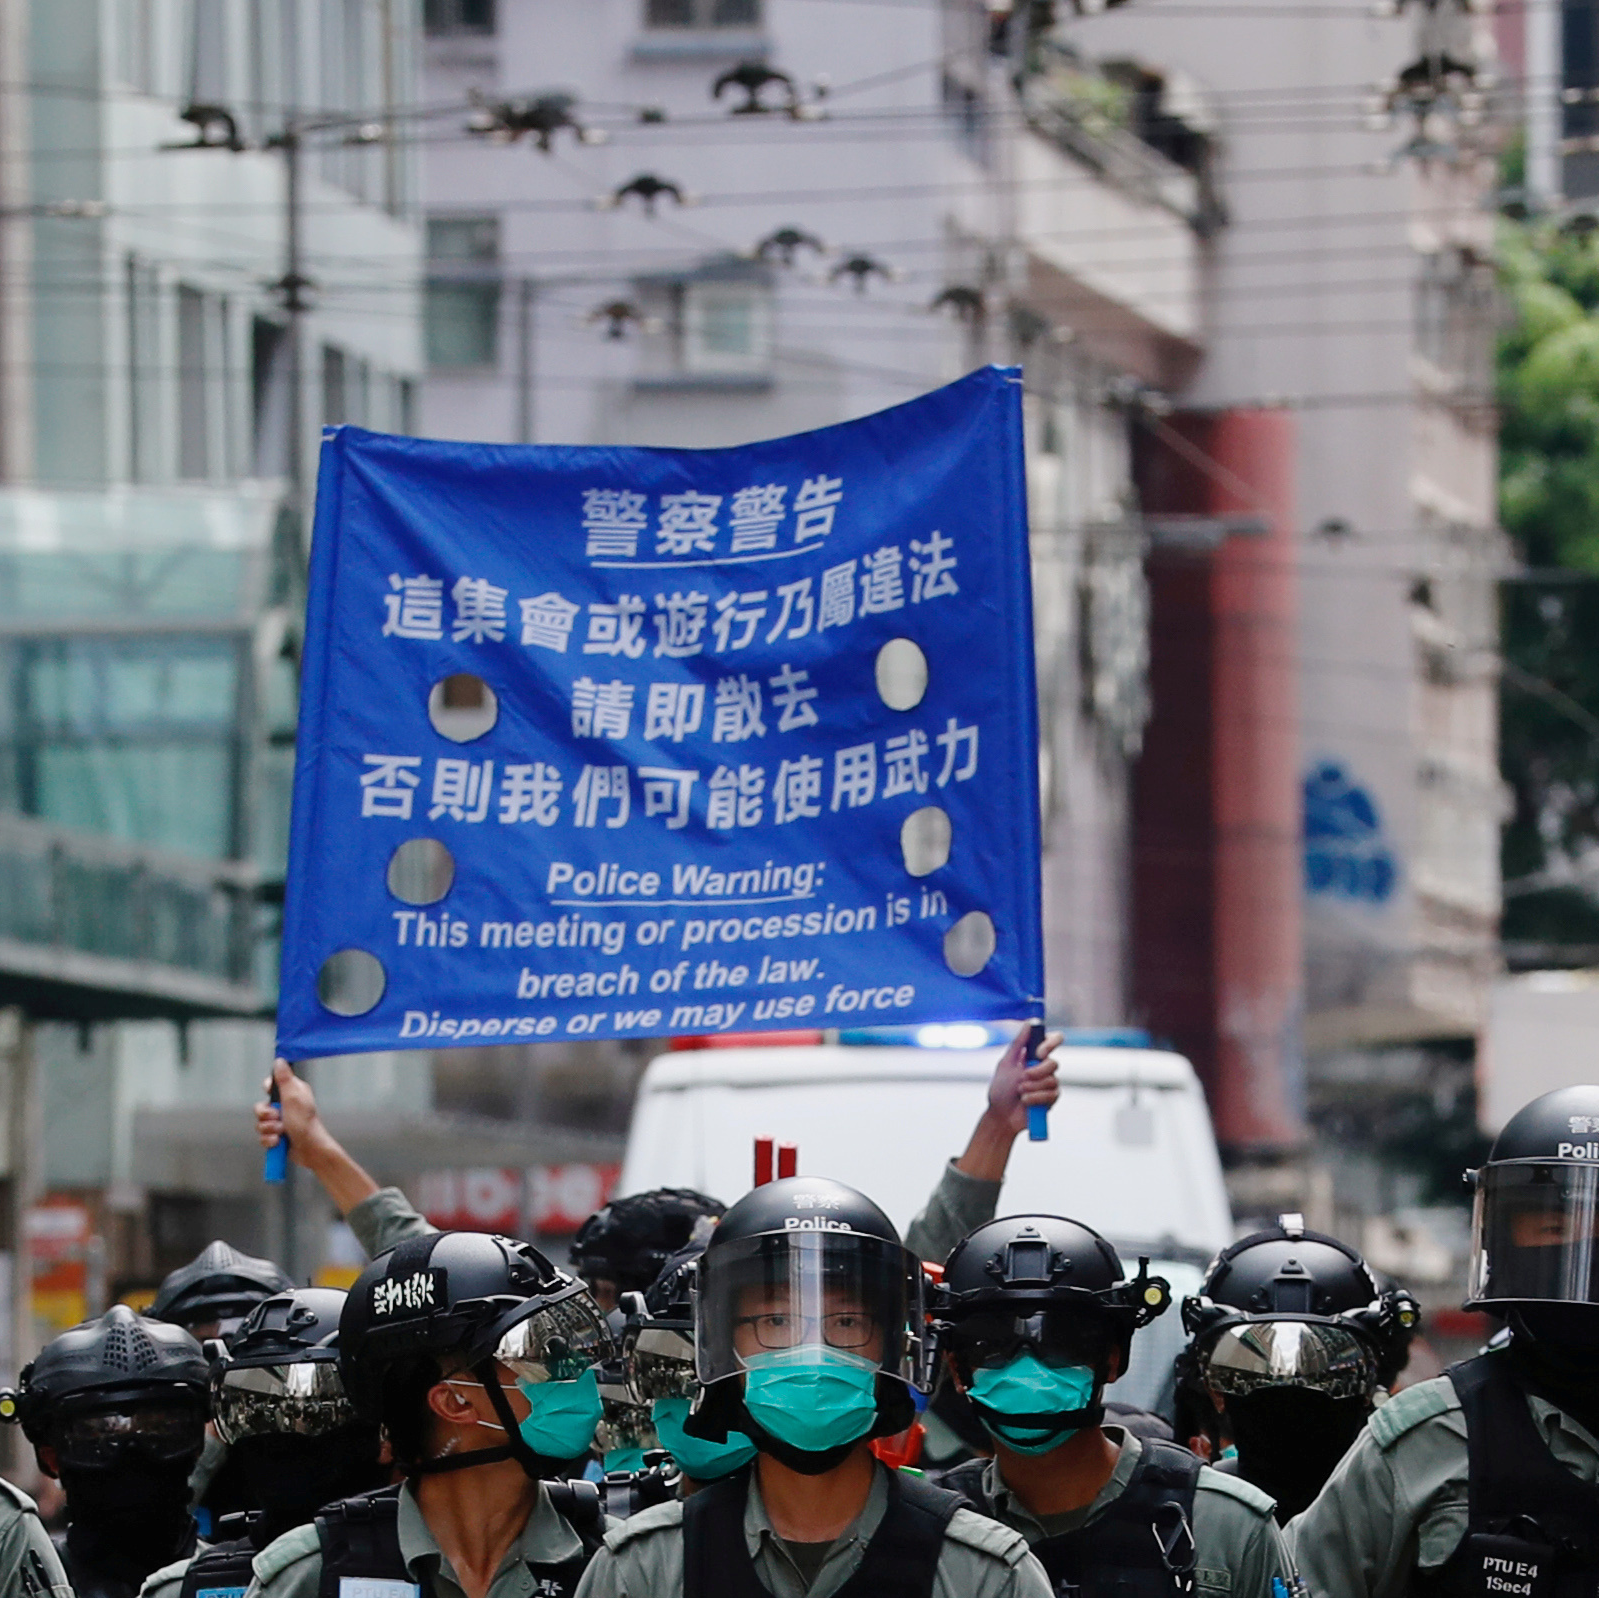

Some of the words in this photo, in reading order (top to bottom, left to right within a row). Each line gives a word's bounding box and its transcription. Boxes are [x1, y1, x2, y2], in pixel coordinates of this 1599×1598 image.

[582, 474, 843, 559] 警察警告
[382, 530, 960, 659] 這集會或遊行乃屬違法
[571, 664, 819, 743] 請即散去
[358, 718, 980, 831] 否則我們可能使用武力
[546, 862, 659, 896] Police
[672, 860, 826, 899] Warning:
[392, 911, 469, 949] This
[480, 916, 626, 954] meeting
[636, 918, 672, 946] or
[682, 905, 877, 953] procession
[887, 894, 912, 926] is
[920, 885, 948, 920] in
[517, 965, 639, 1001] breach
[646, 962, 688, 996] of
[694, 959, 748, 992] the
[757, 954, 826, 985] law.
[399, 1009, 556, 1040] Disperse
[565, 1012, 602, 1036] or
[609, 1009, 662, 1033] we
[672, 1005, 744, 1036] may
[754, 995, 815, 1024] use
[824, 980, 915, 1013] force
[785, 1216, 852, 1231] Police
[1483, 1556, 1514, 1573] PTU
[1515, 1562, 1538, 1578] E4
[1486, 1576, 1532, 1596] 1Sec4
